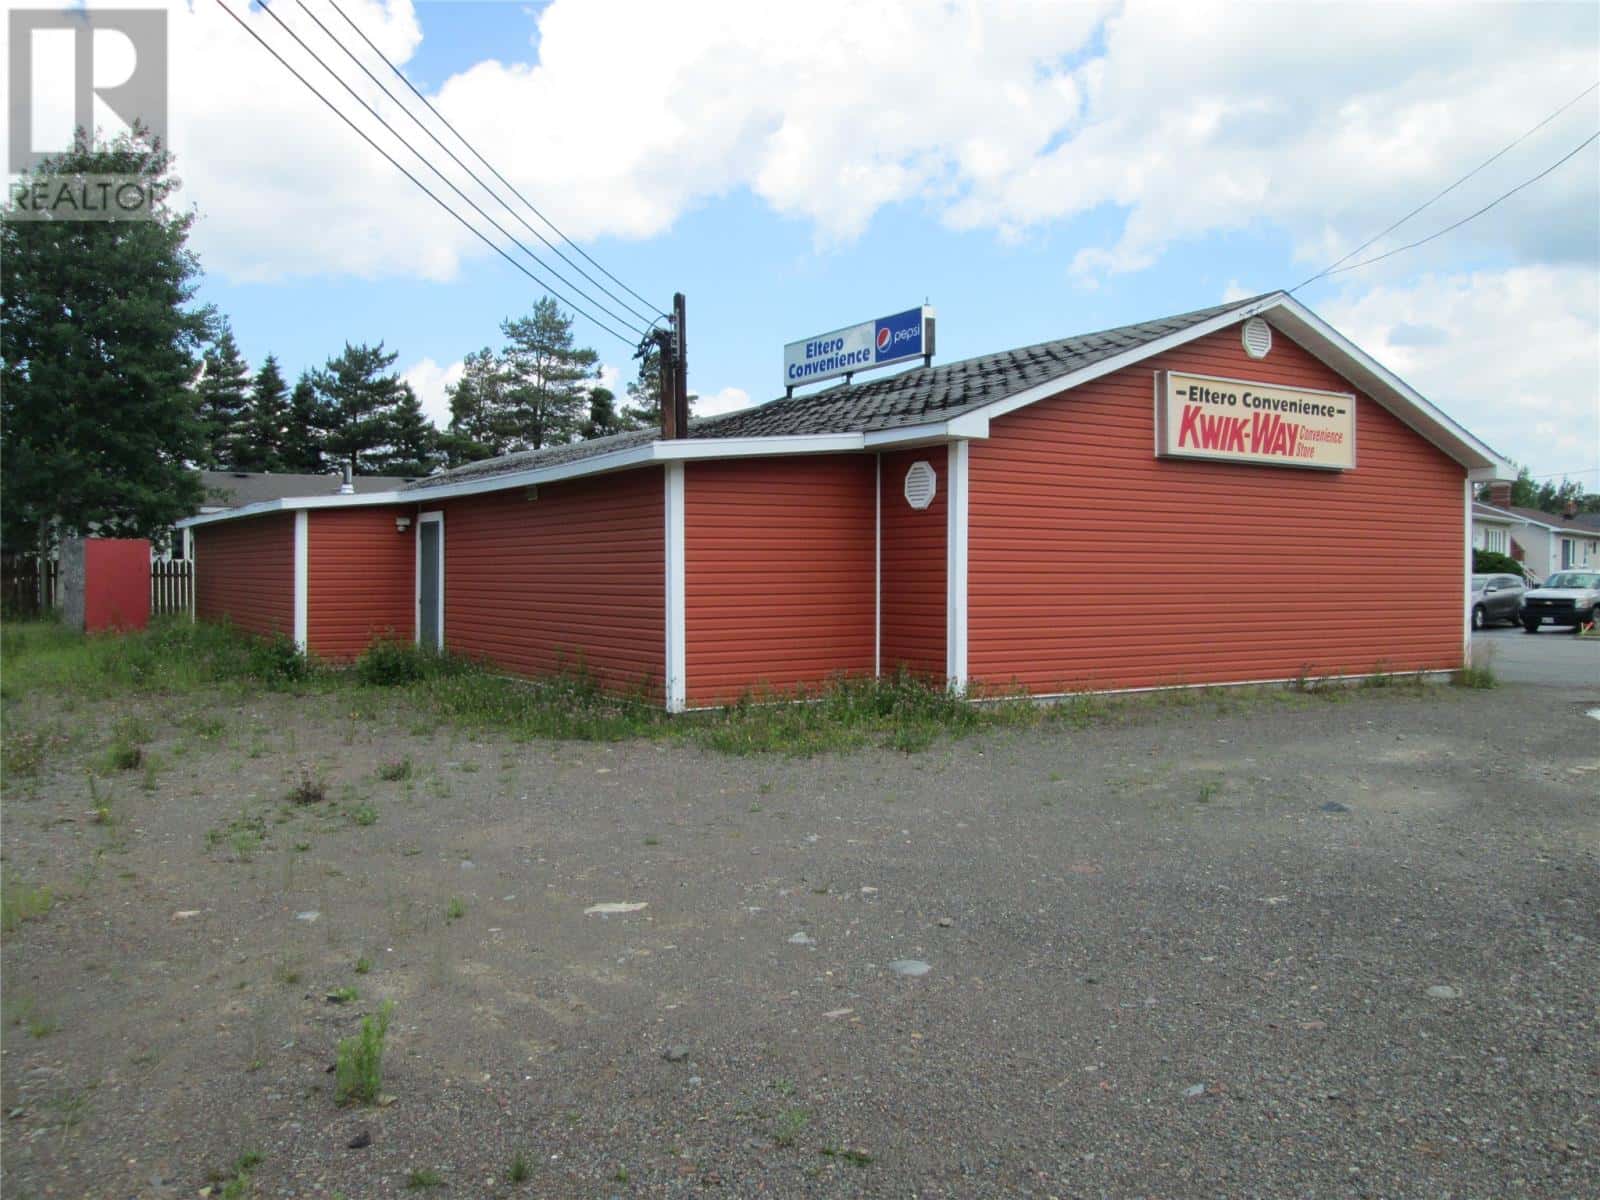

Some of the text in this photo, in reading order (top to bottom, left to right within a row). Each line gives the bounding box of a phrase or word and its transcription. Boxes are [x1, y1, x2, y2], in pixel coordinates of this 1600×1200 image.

[894, 323, 920, 344] pepsi
[805, 336, 844, 359] Eltero
[788, 347, 870, 379] Convenience
[1299, 425, 1343, 444] Convenience
[1296, 442, 1315, 459] Store
